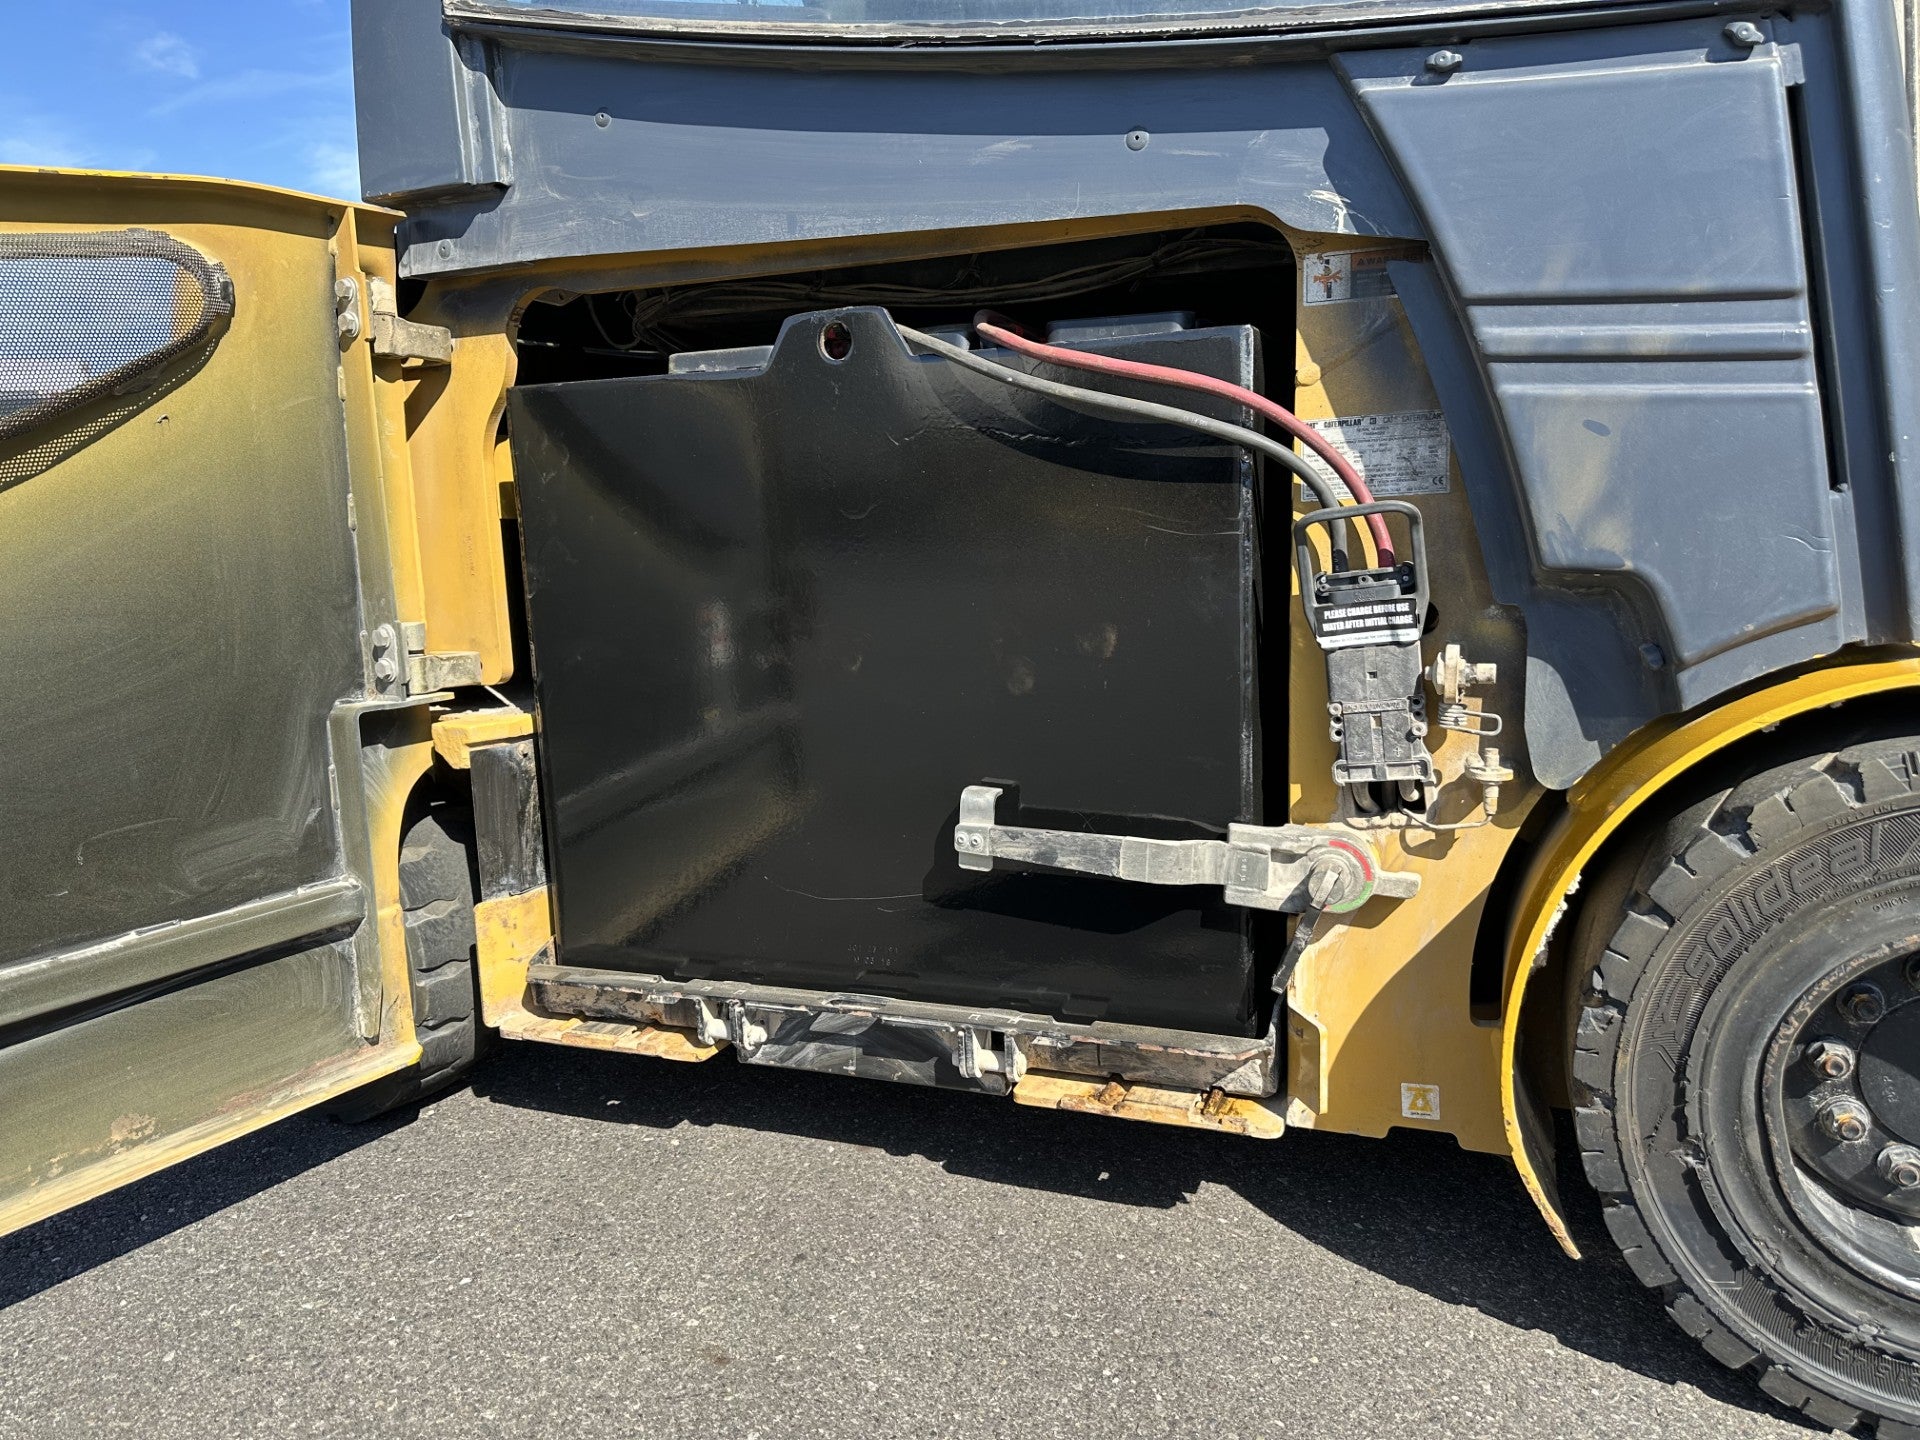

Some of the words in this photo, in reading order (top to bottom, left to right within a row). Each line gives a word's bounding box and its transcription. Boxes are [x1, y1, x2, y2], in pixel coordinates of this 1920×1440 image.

[1323, 418, 1362, 428] CATERPILLAR
[1324, 608, 1347, 620] PLEASE
[1347, 605, 1373, 617] CHARGE
[1373, 604, 1396, 614] BEFORE
[1396, 602, 1410, 612] USE
[1322, 621, 1345, 632] WATER
[1345, 619, 1365, 630] AFTER
[1364, 617, 1388, 627] INITIAL
[1388, 614, 1413, 625] CHARGE
[1872, 804, 1898, 815] LINE
[1684, 823, 1882, 988] solideal
[1872, 895, 1909, 912] QUICK
